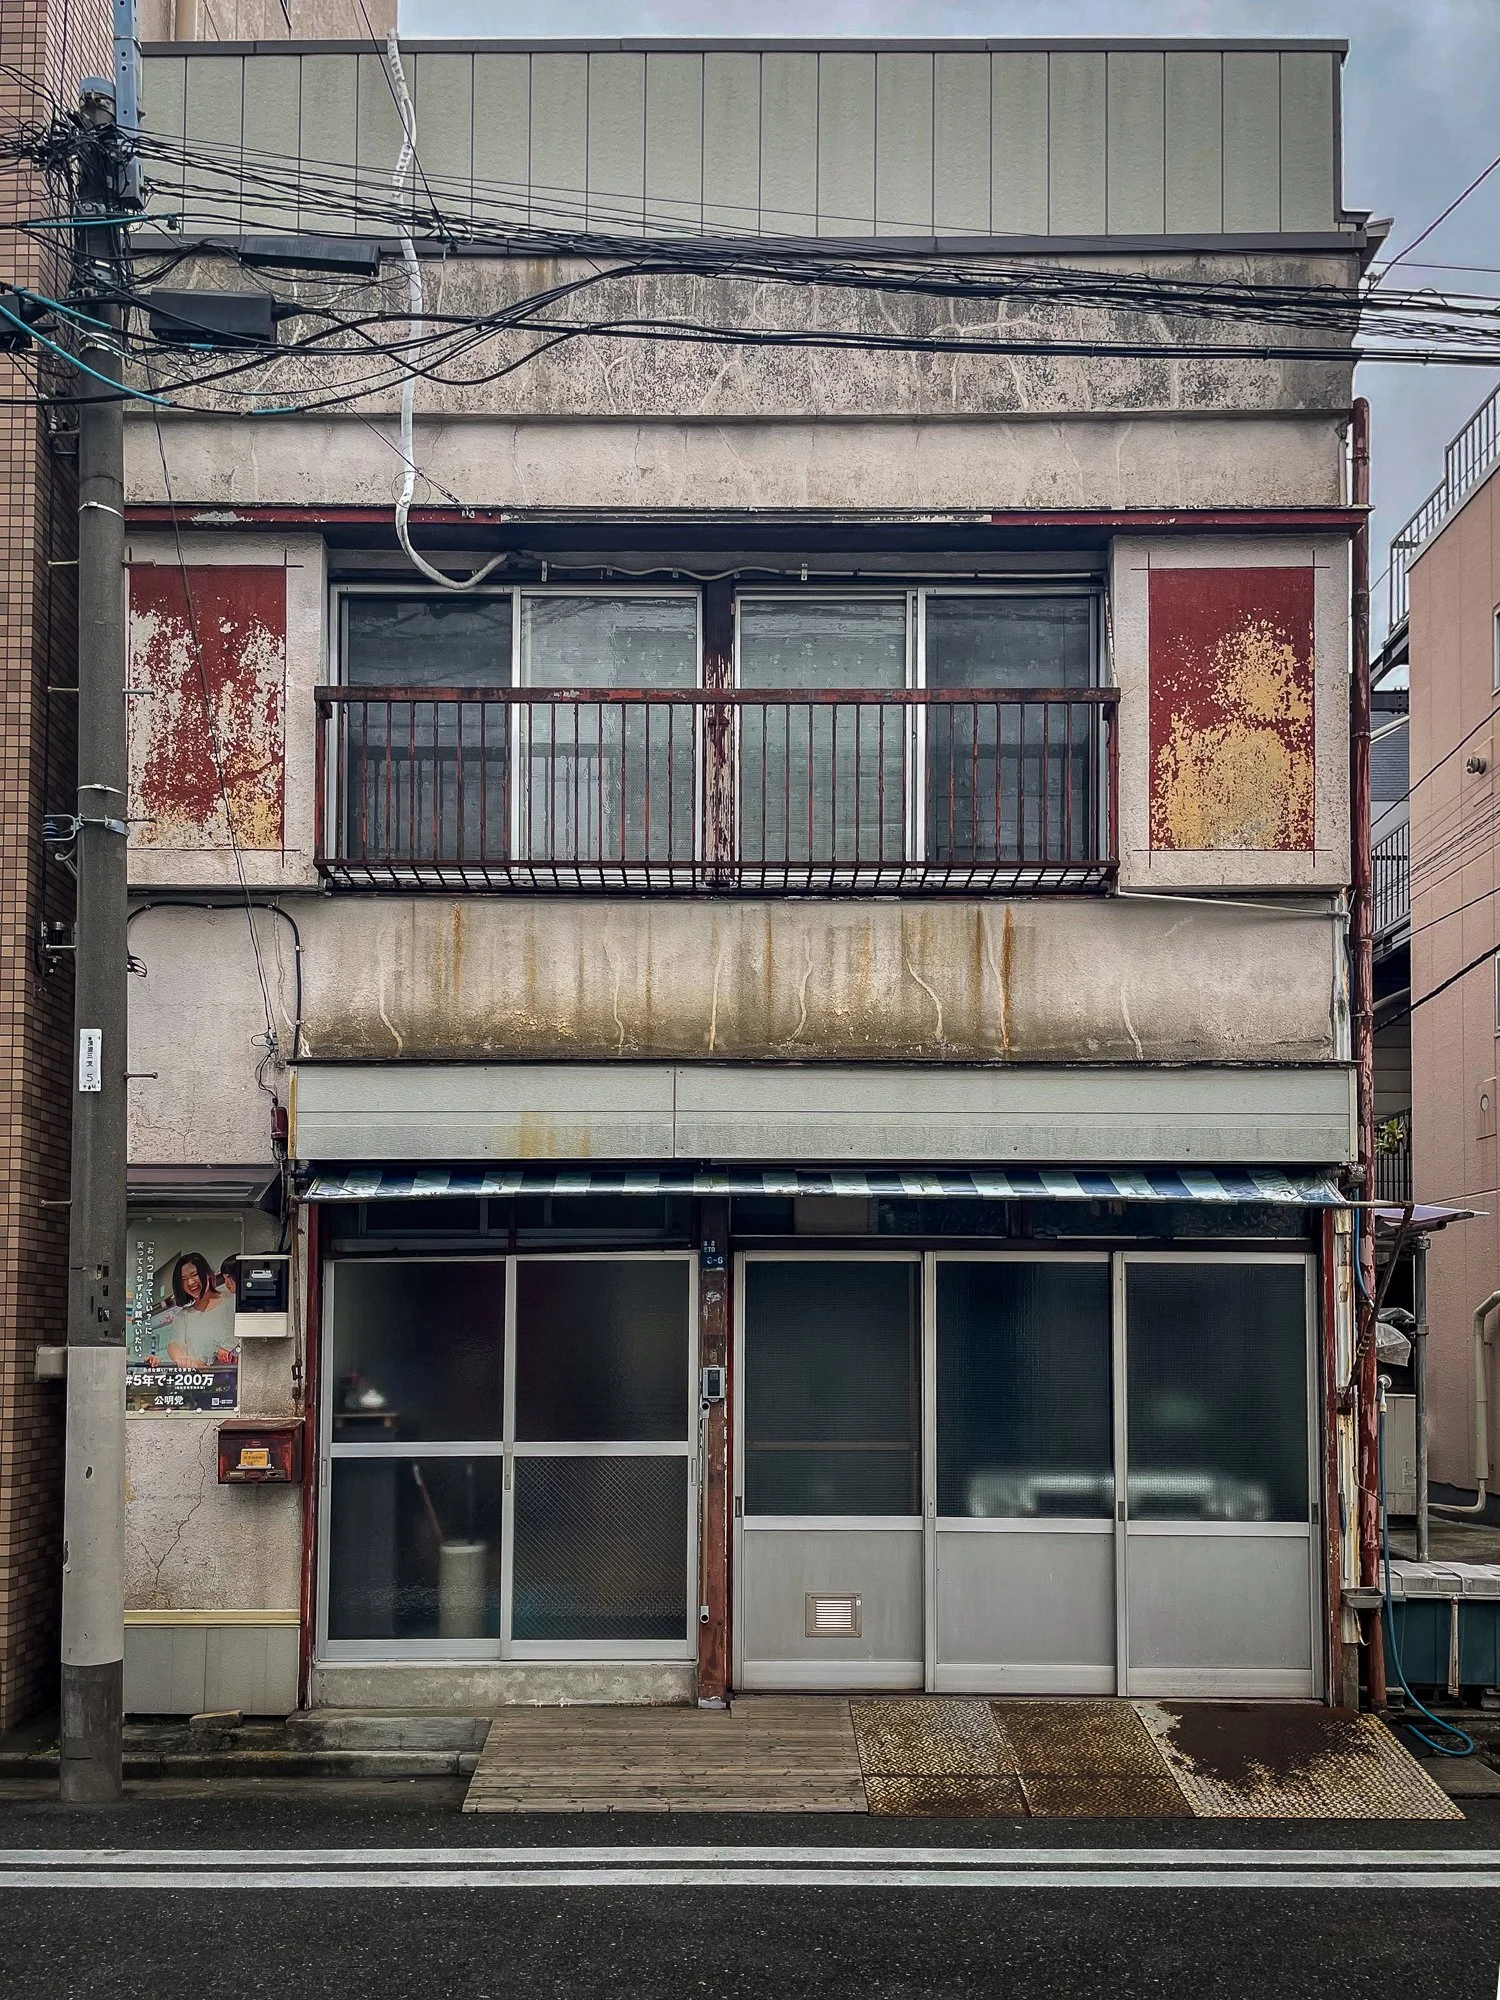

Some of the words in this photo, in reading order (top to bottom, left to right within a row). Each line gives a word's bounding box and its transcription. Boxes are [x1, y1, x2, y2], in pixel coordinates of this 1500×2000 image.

[86, 1074, 94, 1082] 5
[154, 1395, 184, 1405] 公明党
